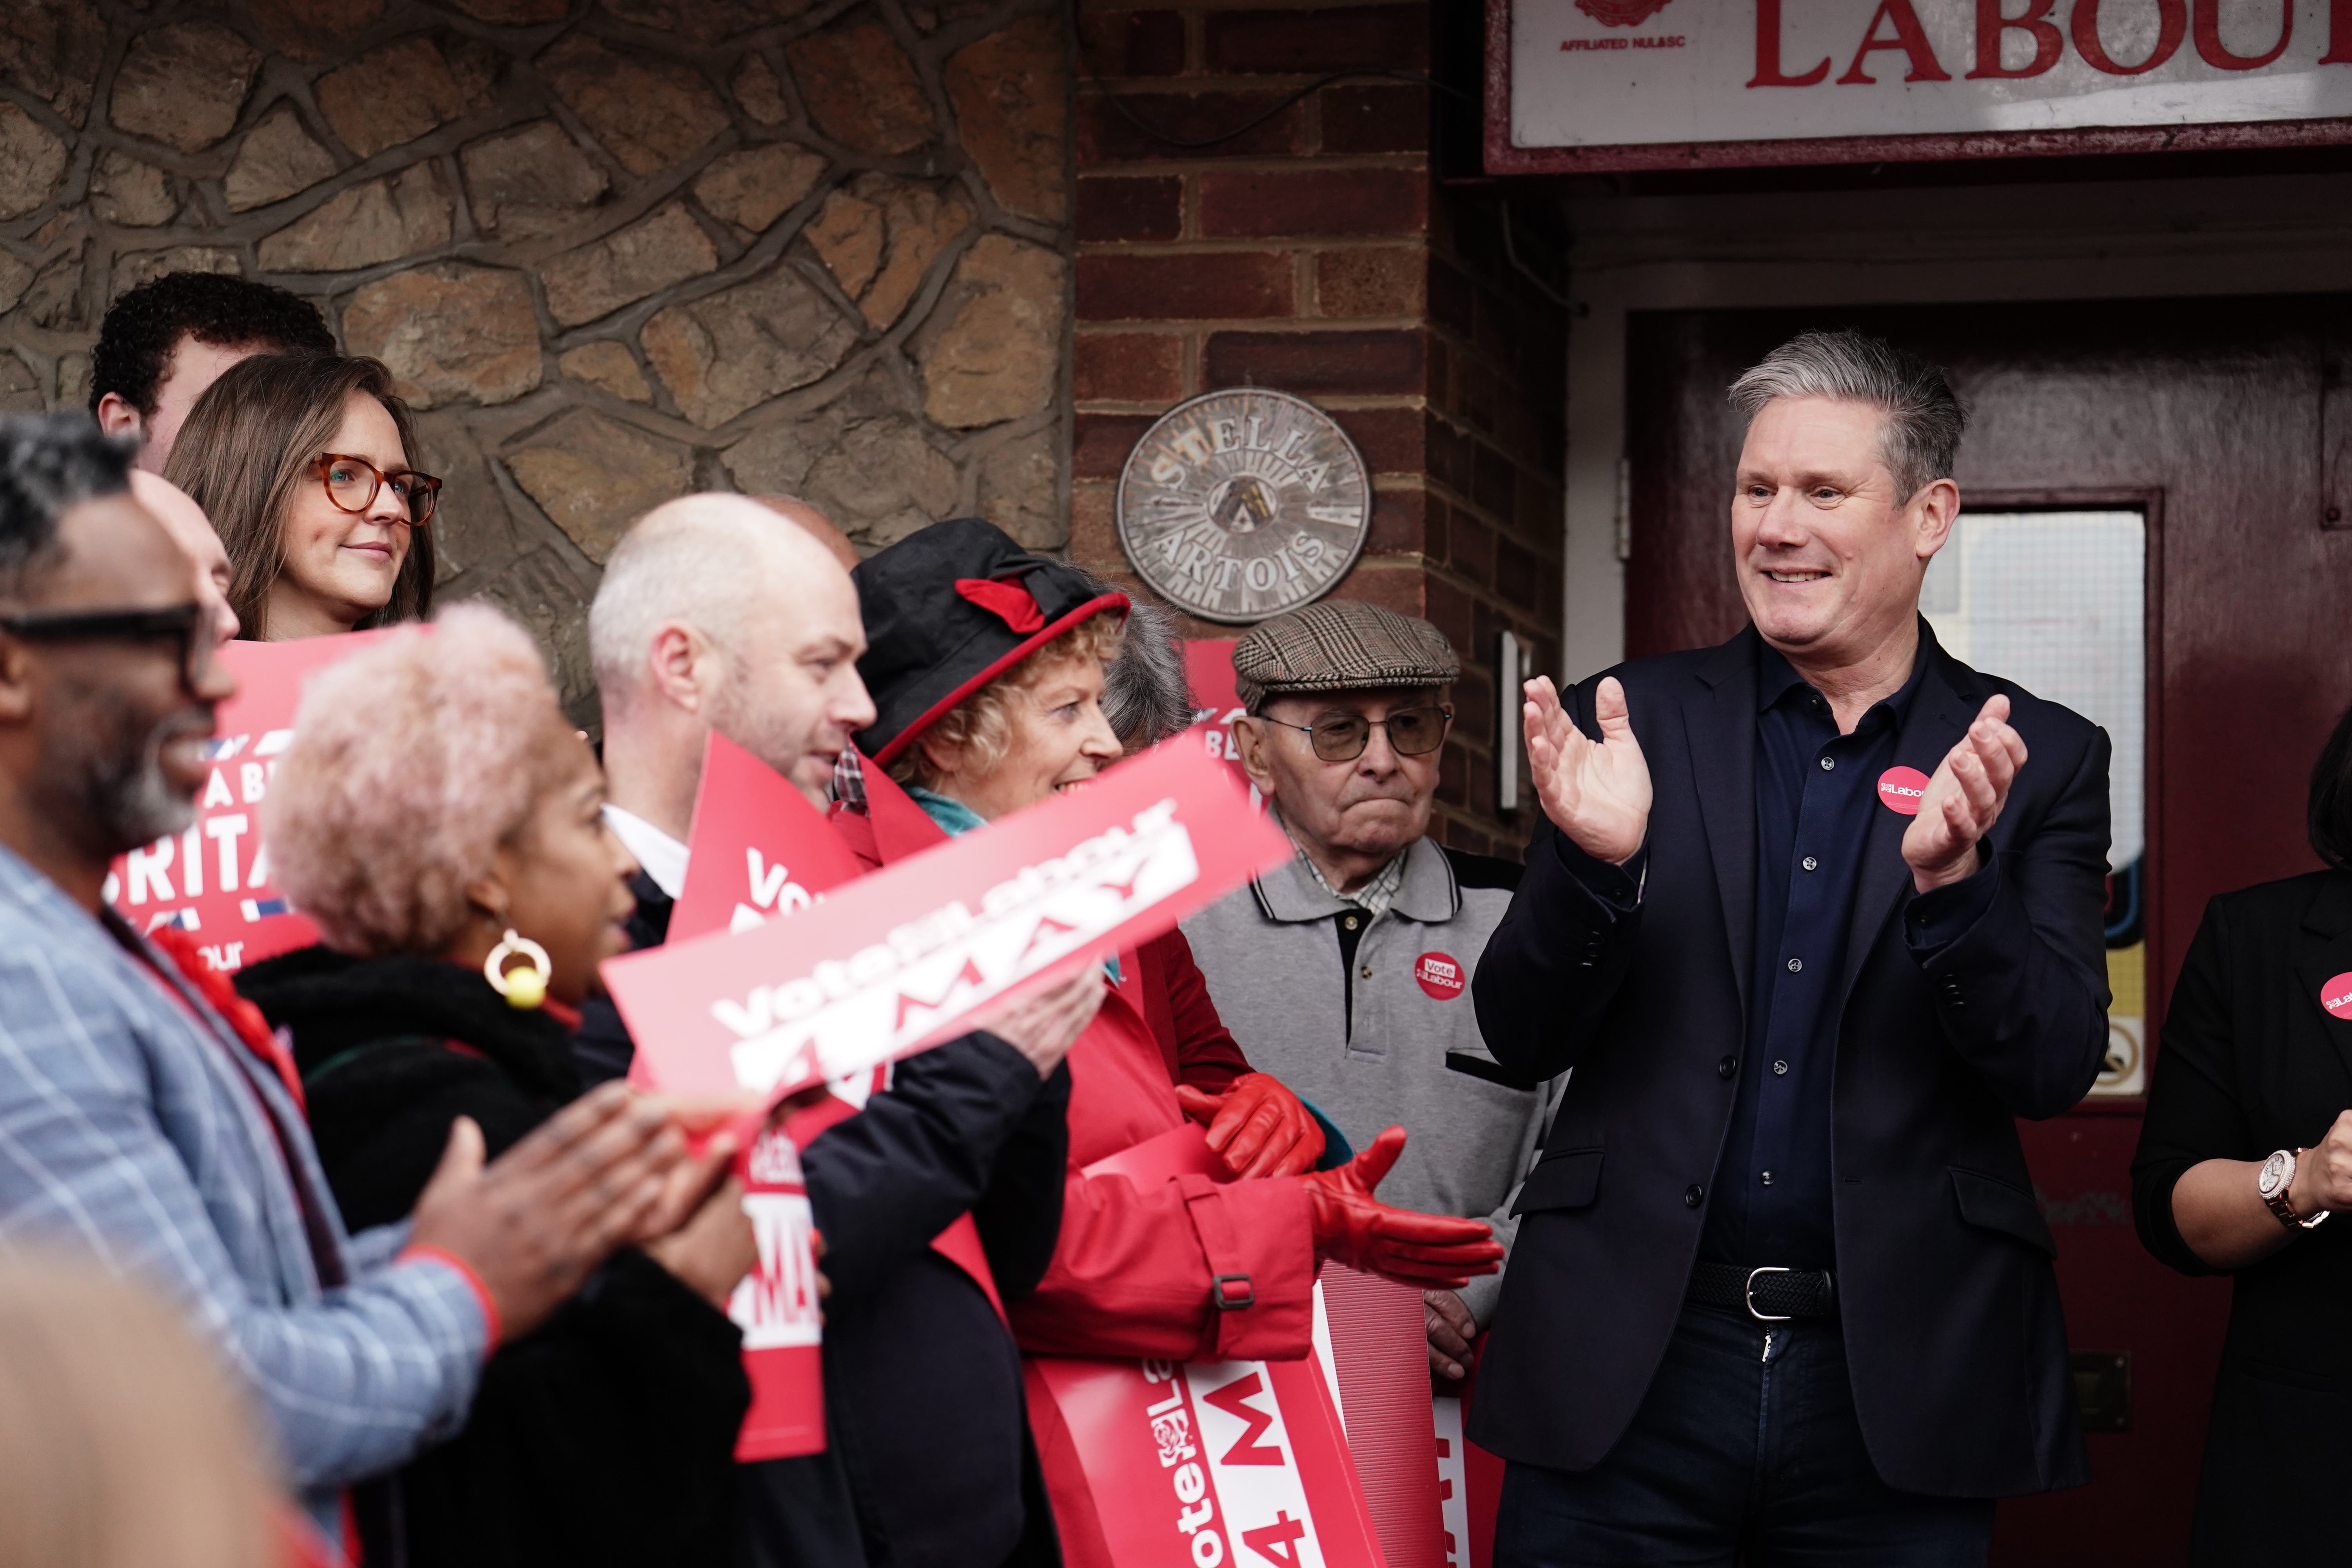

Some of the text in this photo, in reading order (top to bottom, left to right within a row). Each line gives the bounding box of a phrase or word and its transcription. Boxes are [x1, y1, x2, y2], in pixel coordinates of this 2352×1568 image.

[1560, 38, 1628, 51] AFFILIATED
[1745, 0, 2352, 88] LABOU
[1151, 415, 1331, 493] STELLA
[1153, 530, 1327, 592] ARTOIS
[203, 766, 234, 809] A
[710, 797, 1176, 1039] Vote Labour
[887, 848, 1163, 1042] MAY
[1426, 961, 1453, 976] Vote
[1426, 971, 1463, 990] Labour
[1142, 1359, 1223, 1568] ote La
[1202, 1370, 1306, 1568] 4 M
